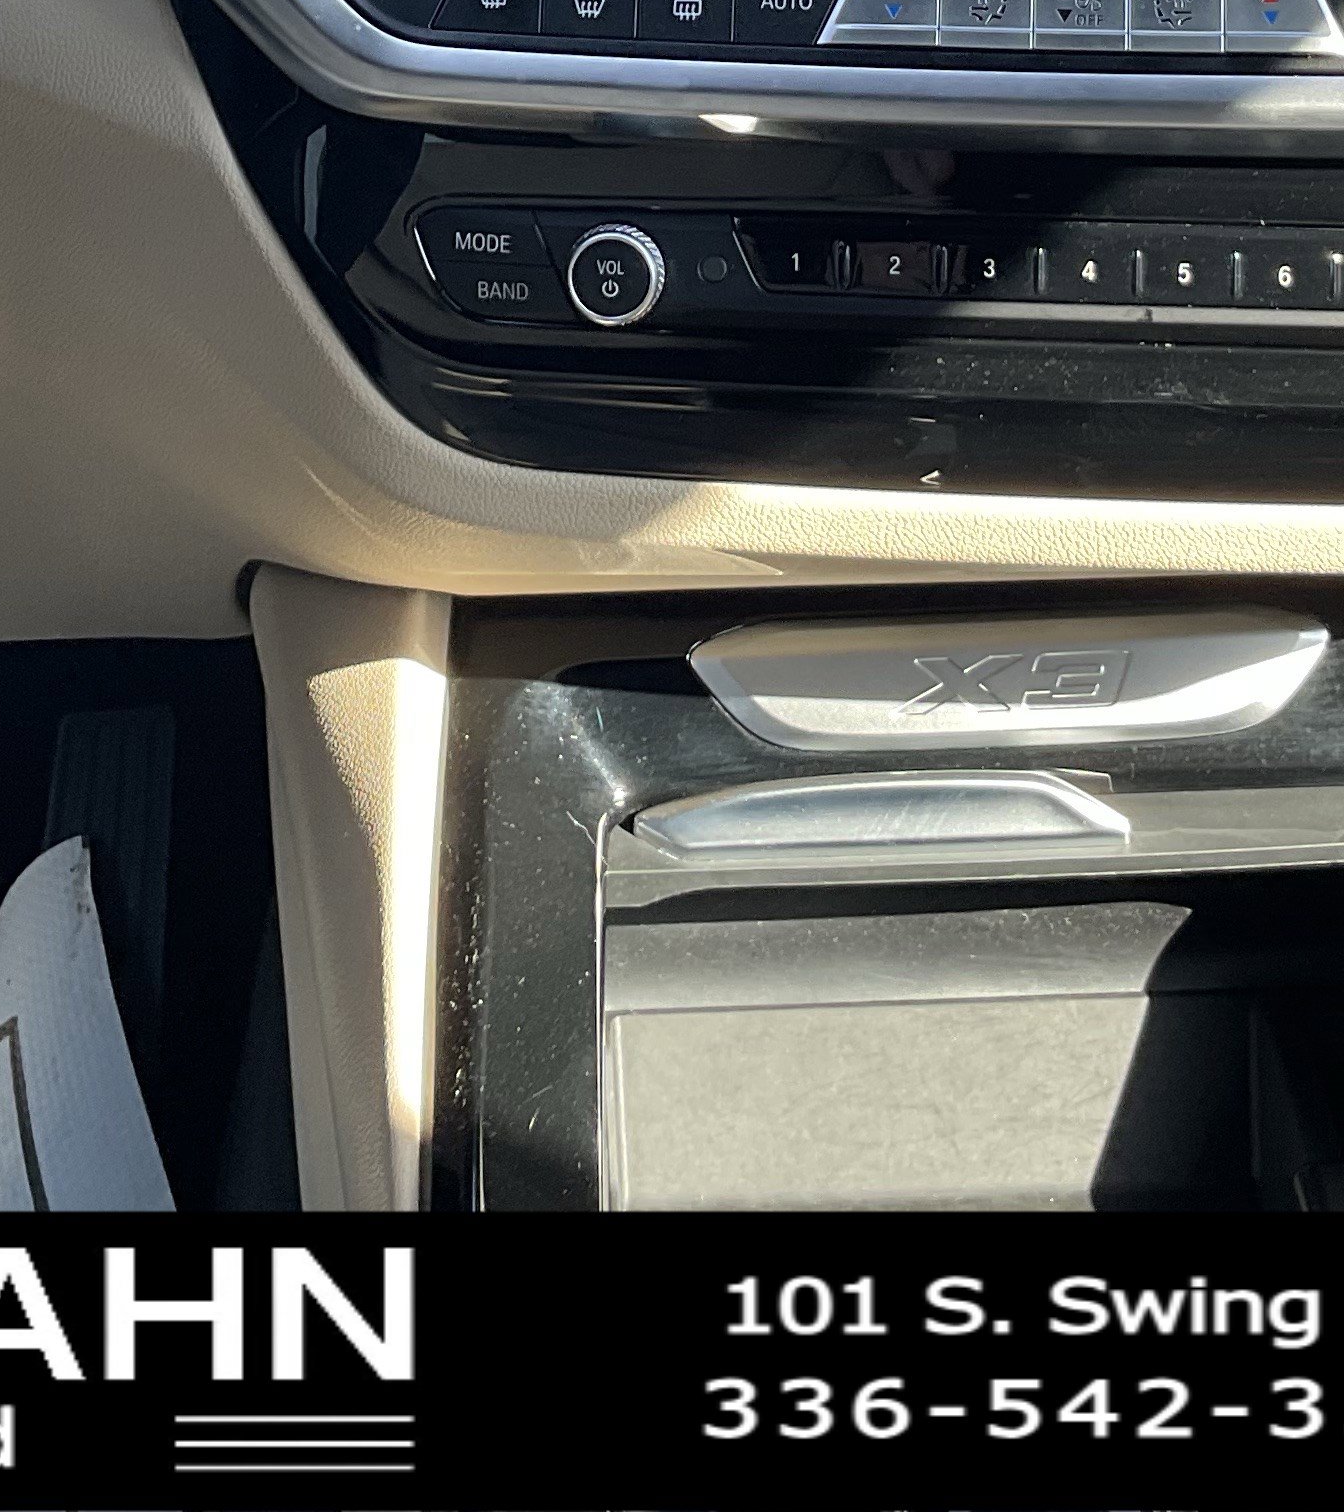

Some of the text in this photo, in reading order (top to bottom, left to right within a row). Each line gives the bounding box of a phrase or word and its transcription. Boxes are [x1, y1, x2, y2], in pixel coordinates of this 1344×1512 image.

[1075, 13, 1104, 27] OFF
[455, 231, 512, 255] MODE
[596, 259, 625, 276] VOL
[790, 252, 801, 273] 1
[888, 255, 902, 276] 2
[983, 257, 997, 278] 3
[1081, 259, 1097, 282] 4
[1178, 261, 1192, 283] 5
[1277, 265, 1293, 287] 6
[476, 279, 530, 302] BAND
[893, 649, 1133, 716] X3
